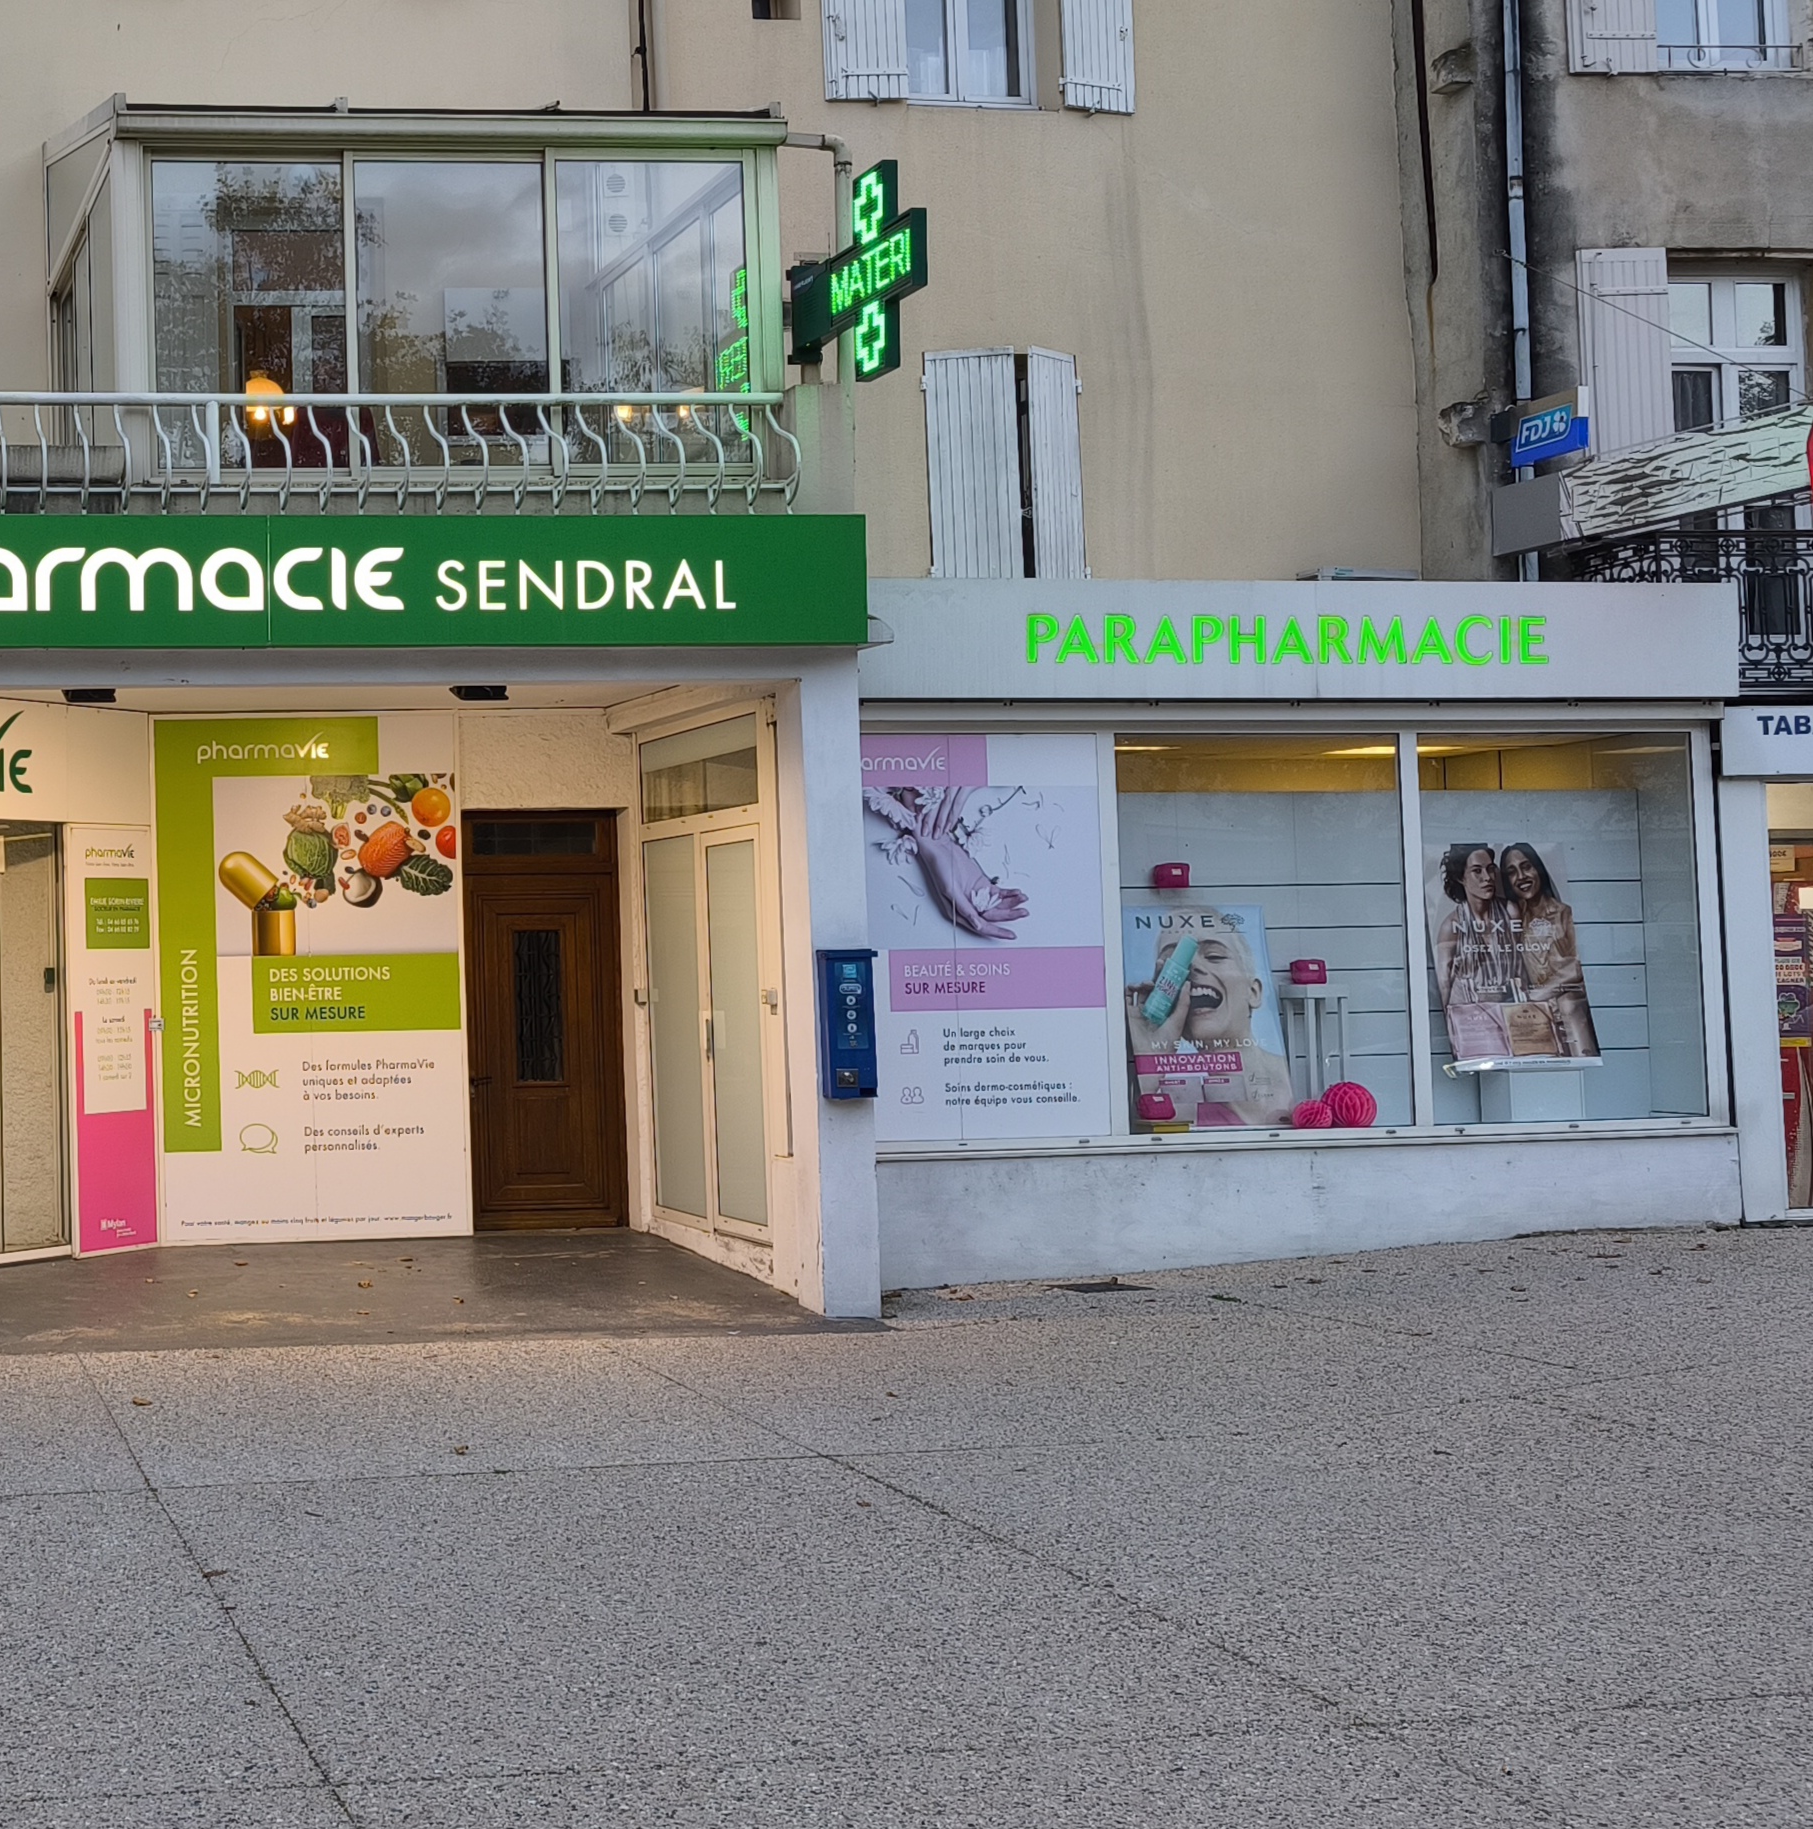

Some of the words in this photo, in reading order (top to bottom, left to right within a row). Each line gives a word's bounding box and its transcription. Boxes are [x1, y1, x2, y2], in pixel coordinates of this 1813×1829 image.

[831, 228, 911, 314] MATERI
[1521, 419, 1551, 445] FDJ
[436, 559, 736, 612] SENDRAL
[1026, 613, 1549, 665] PARAPHARMACIE
[1757, 715, 1813, 735] TAB
[1135, 915, 1215, 929] NUXE
[1452, 920, 1523, 933] NUXE
[1463, 944, 1492, 953] OSEZ
[1498, 944, 1512, 952] LE
[1516, 942, 1551, 952] GLOW
[269, 968, 298, 982] DES
[302, 966, 391, 981] SOLUTIONS
[904, 962, 952, 977] BEAUTÉ
[956, 965, 965, 976] &
[969, 964, 1011, 976] SOINS
[270, 984, 342, 1001] BIEN-ÊTRE
[905, 983, 930, 994] SUR
[935, 981, 986, 994] MESURE
[270, 1008, 300, 1021] SUR
[305, 1006, 366, 1020] MESURE
[180, 949, 202, 1127] MICRONUTRITION
[943, 1028, 956, 1038] Un
[960, 1028, 985, 1040] large
[989, 1027, 1016, 1037] choix
[943, 1041, 955, 1051] de
[959, 1042, 1000, 1053] marques
[1004, 1042, 1026, 1052] pour
[1151, 1041, 1168, 1049] MY
[1213, 1039, 1230, 1048] MY
[302, 1061, 323, 1072] Des
[325, 1059, 372, 1071] formules
[376, 1059, 435, 1071] PharmaVie
[944, 1054, 982, 1066] prendre
[986, 1053, 1005, 1063] soin
[1009, 1053, 1021, 1063] de
[1024, 1055, 1049, 1063] vous.
[1154, 1054, 1236, 1065] INNOVATION
[1156, 1063, 1238, 1072] ANTI-BOUTONS
[302, 1075, 344, 1088] uniques
[347, 1076, 358, 1086] et
[361, 1074, 412, 1088] adaptées
[945, 1083, 971, 1093] Soins
[974, 1081, 1066, 1093] dermo-cosmétiques
[303, 1090, 310, 1101] à
[313, 1092, 331, 1100] vos
[335, 1090, 379, 1100] besoins.
[945, 1097, 971, 1106] notre
[974, 1094, 1007, 1106] équipe
[1011, 1096, 1032, 1104] vous
[1036, 1093, 1081, 1103] conseille.
[304, 1126, 324, 1137] Des
[327, 1124, 370, 1137] conseils
[373, 1124, 425, 1138] d'experts
[304, 1140, 381, 1154] personnalisés.
